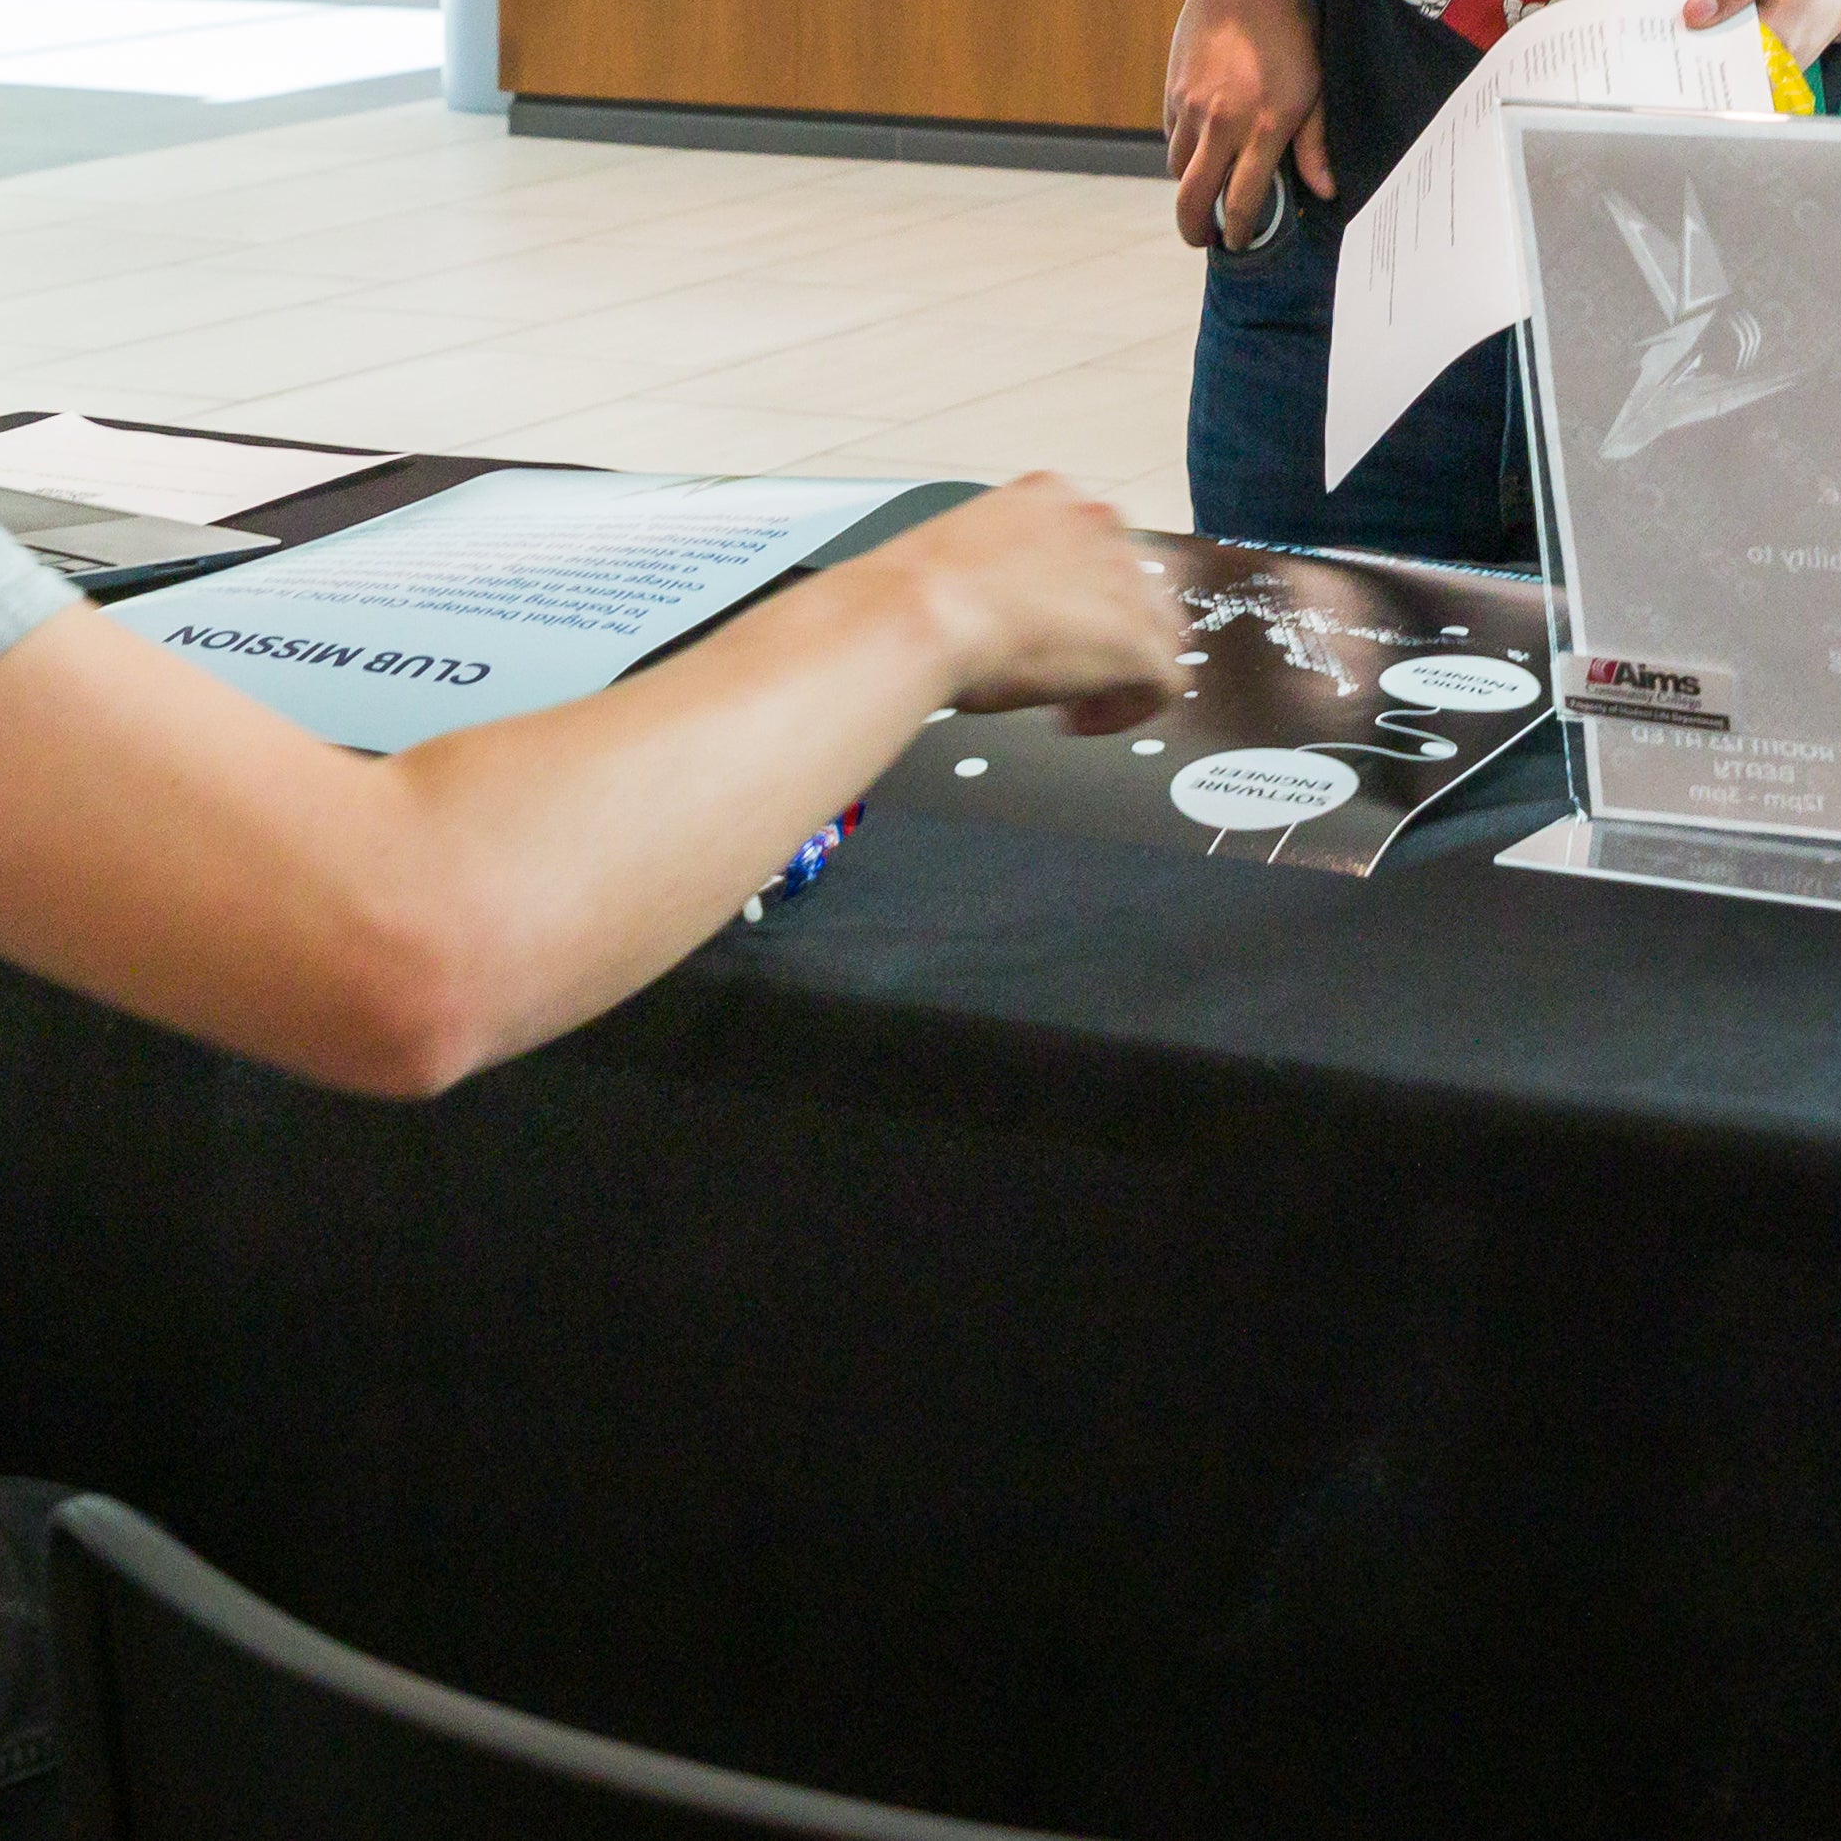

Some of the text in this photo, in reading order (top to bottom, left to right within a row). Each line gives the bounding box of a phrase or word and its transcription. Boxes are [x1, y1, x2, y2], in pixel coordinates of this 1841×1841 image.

[676, 549, 750, 567] where
[540, 581, 565, 592] in
[564, 583, 682, 607] excellence
[622, 574, 706, 593] college
[358, 594, 412, 610] Club
[402, 597, 522, 623] Developer
[522, 592, 625, 619] fostering
[625, 606, 649, 620] to
[521, 609, 601, 632] Digital
[602, 620, 641, 637] The
[162, 624, 492, 686] CLUB MISSION
[1411, 665, 1519, 693] ENGINEER
[1421, 677, 1494, 697] AUDIO
[1613, 661, 1701, 696] Aims
[1207, 764, 1335, 792] ENGINEER
[1188, 777, 1332, 808] SOFTWARE
